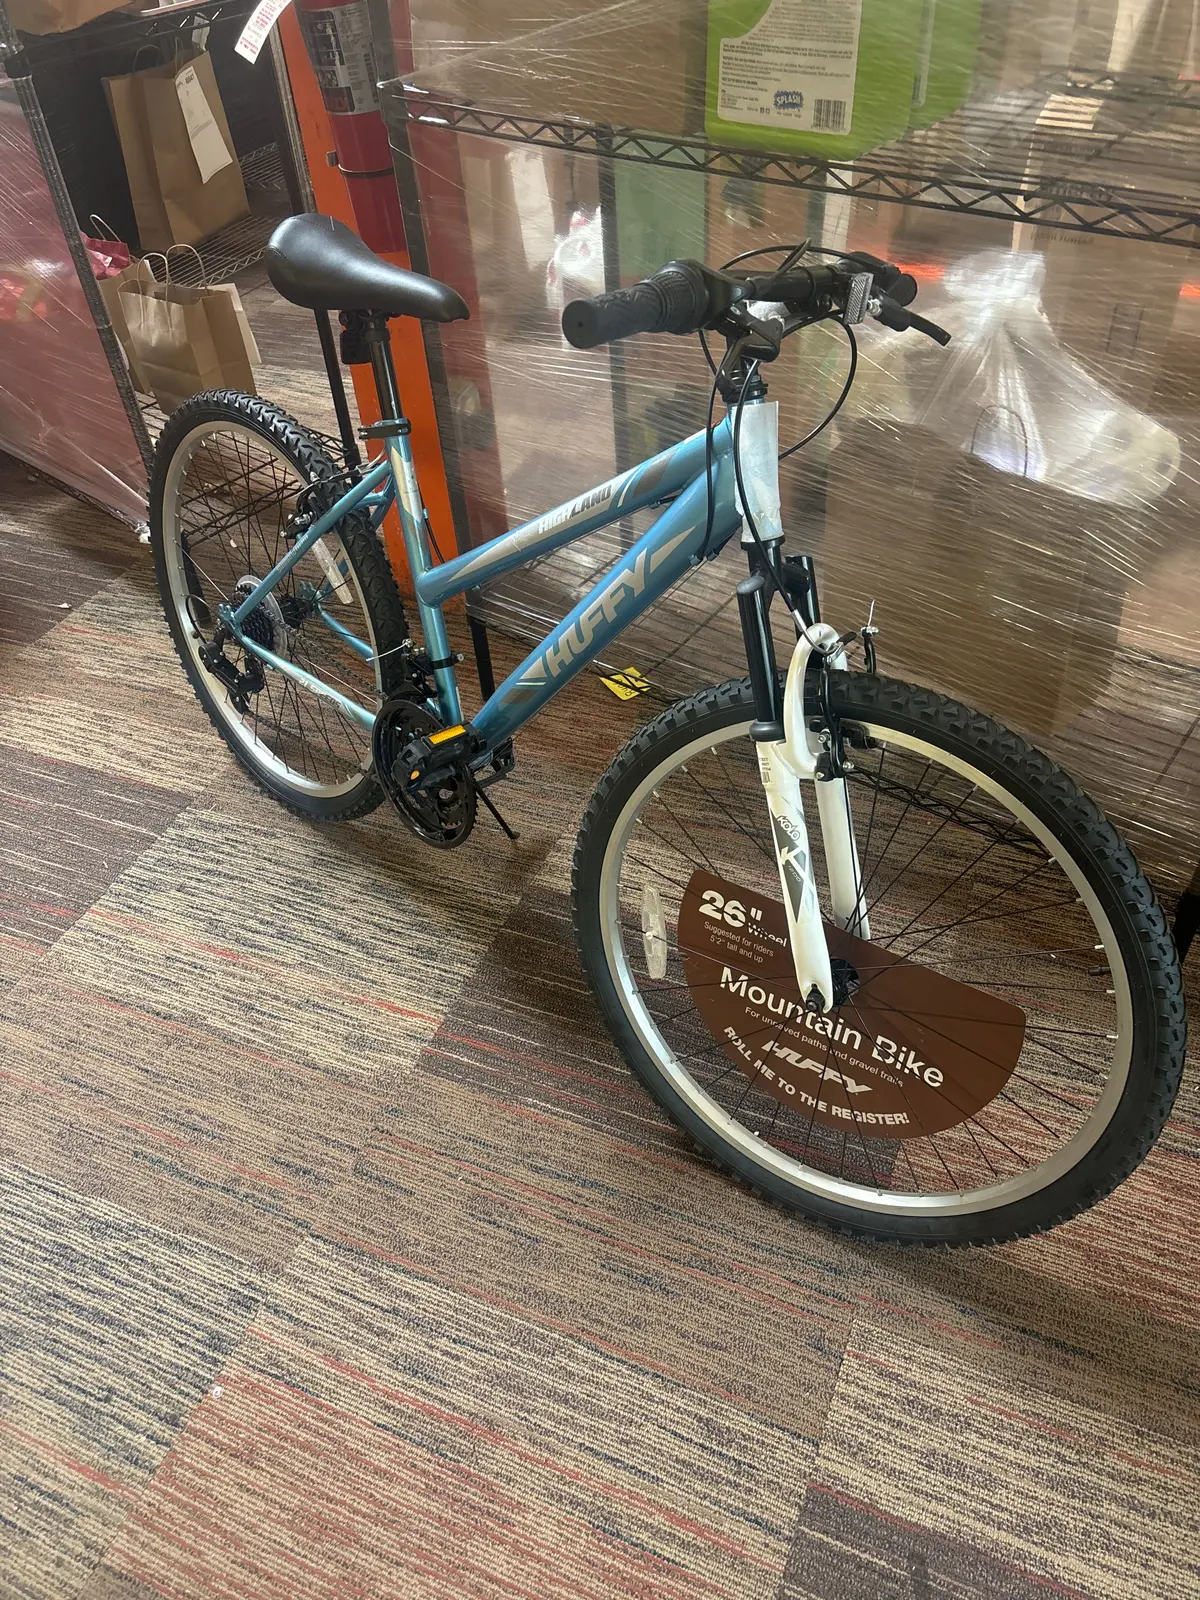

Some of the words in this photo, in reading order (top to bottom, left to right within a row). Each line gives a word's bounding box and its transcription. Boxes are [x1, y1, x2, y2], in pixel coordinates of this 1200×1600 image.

[776, 94, 801, 106] SPLASH
[538, 484, 612, 535] HIGHLAND
[545, 547, 648, 678] HUFFY
[777, 814, 801, 841] KOLO
[703, 920, 741, 943] Suggested
[741, 937, 752, 948] for
[753, 942, 774, 957] riders
[726, 941, 738, 952] tall
[738, 946, 753, 959] and
[753, 954, 763, 963] up
[720, 966, 862, 1050] Mountain
[871, 1035, 944, 1087] Bike
[745, 1006, 761, 1019] For
[801, 1034, 828, 1052] paths
[849, 1057, 879, 1075] gravel
[724, 1026, 753, 1061] ROLL
[753, 1059, 776, 1081] ME
[778, 1077, 796, 1096] TO
[799, 1091, 828, 1113] THE
[831, 1104, 910, 1125] REGISTER!
[761, 1040, 873, 1093] HUFFY
